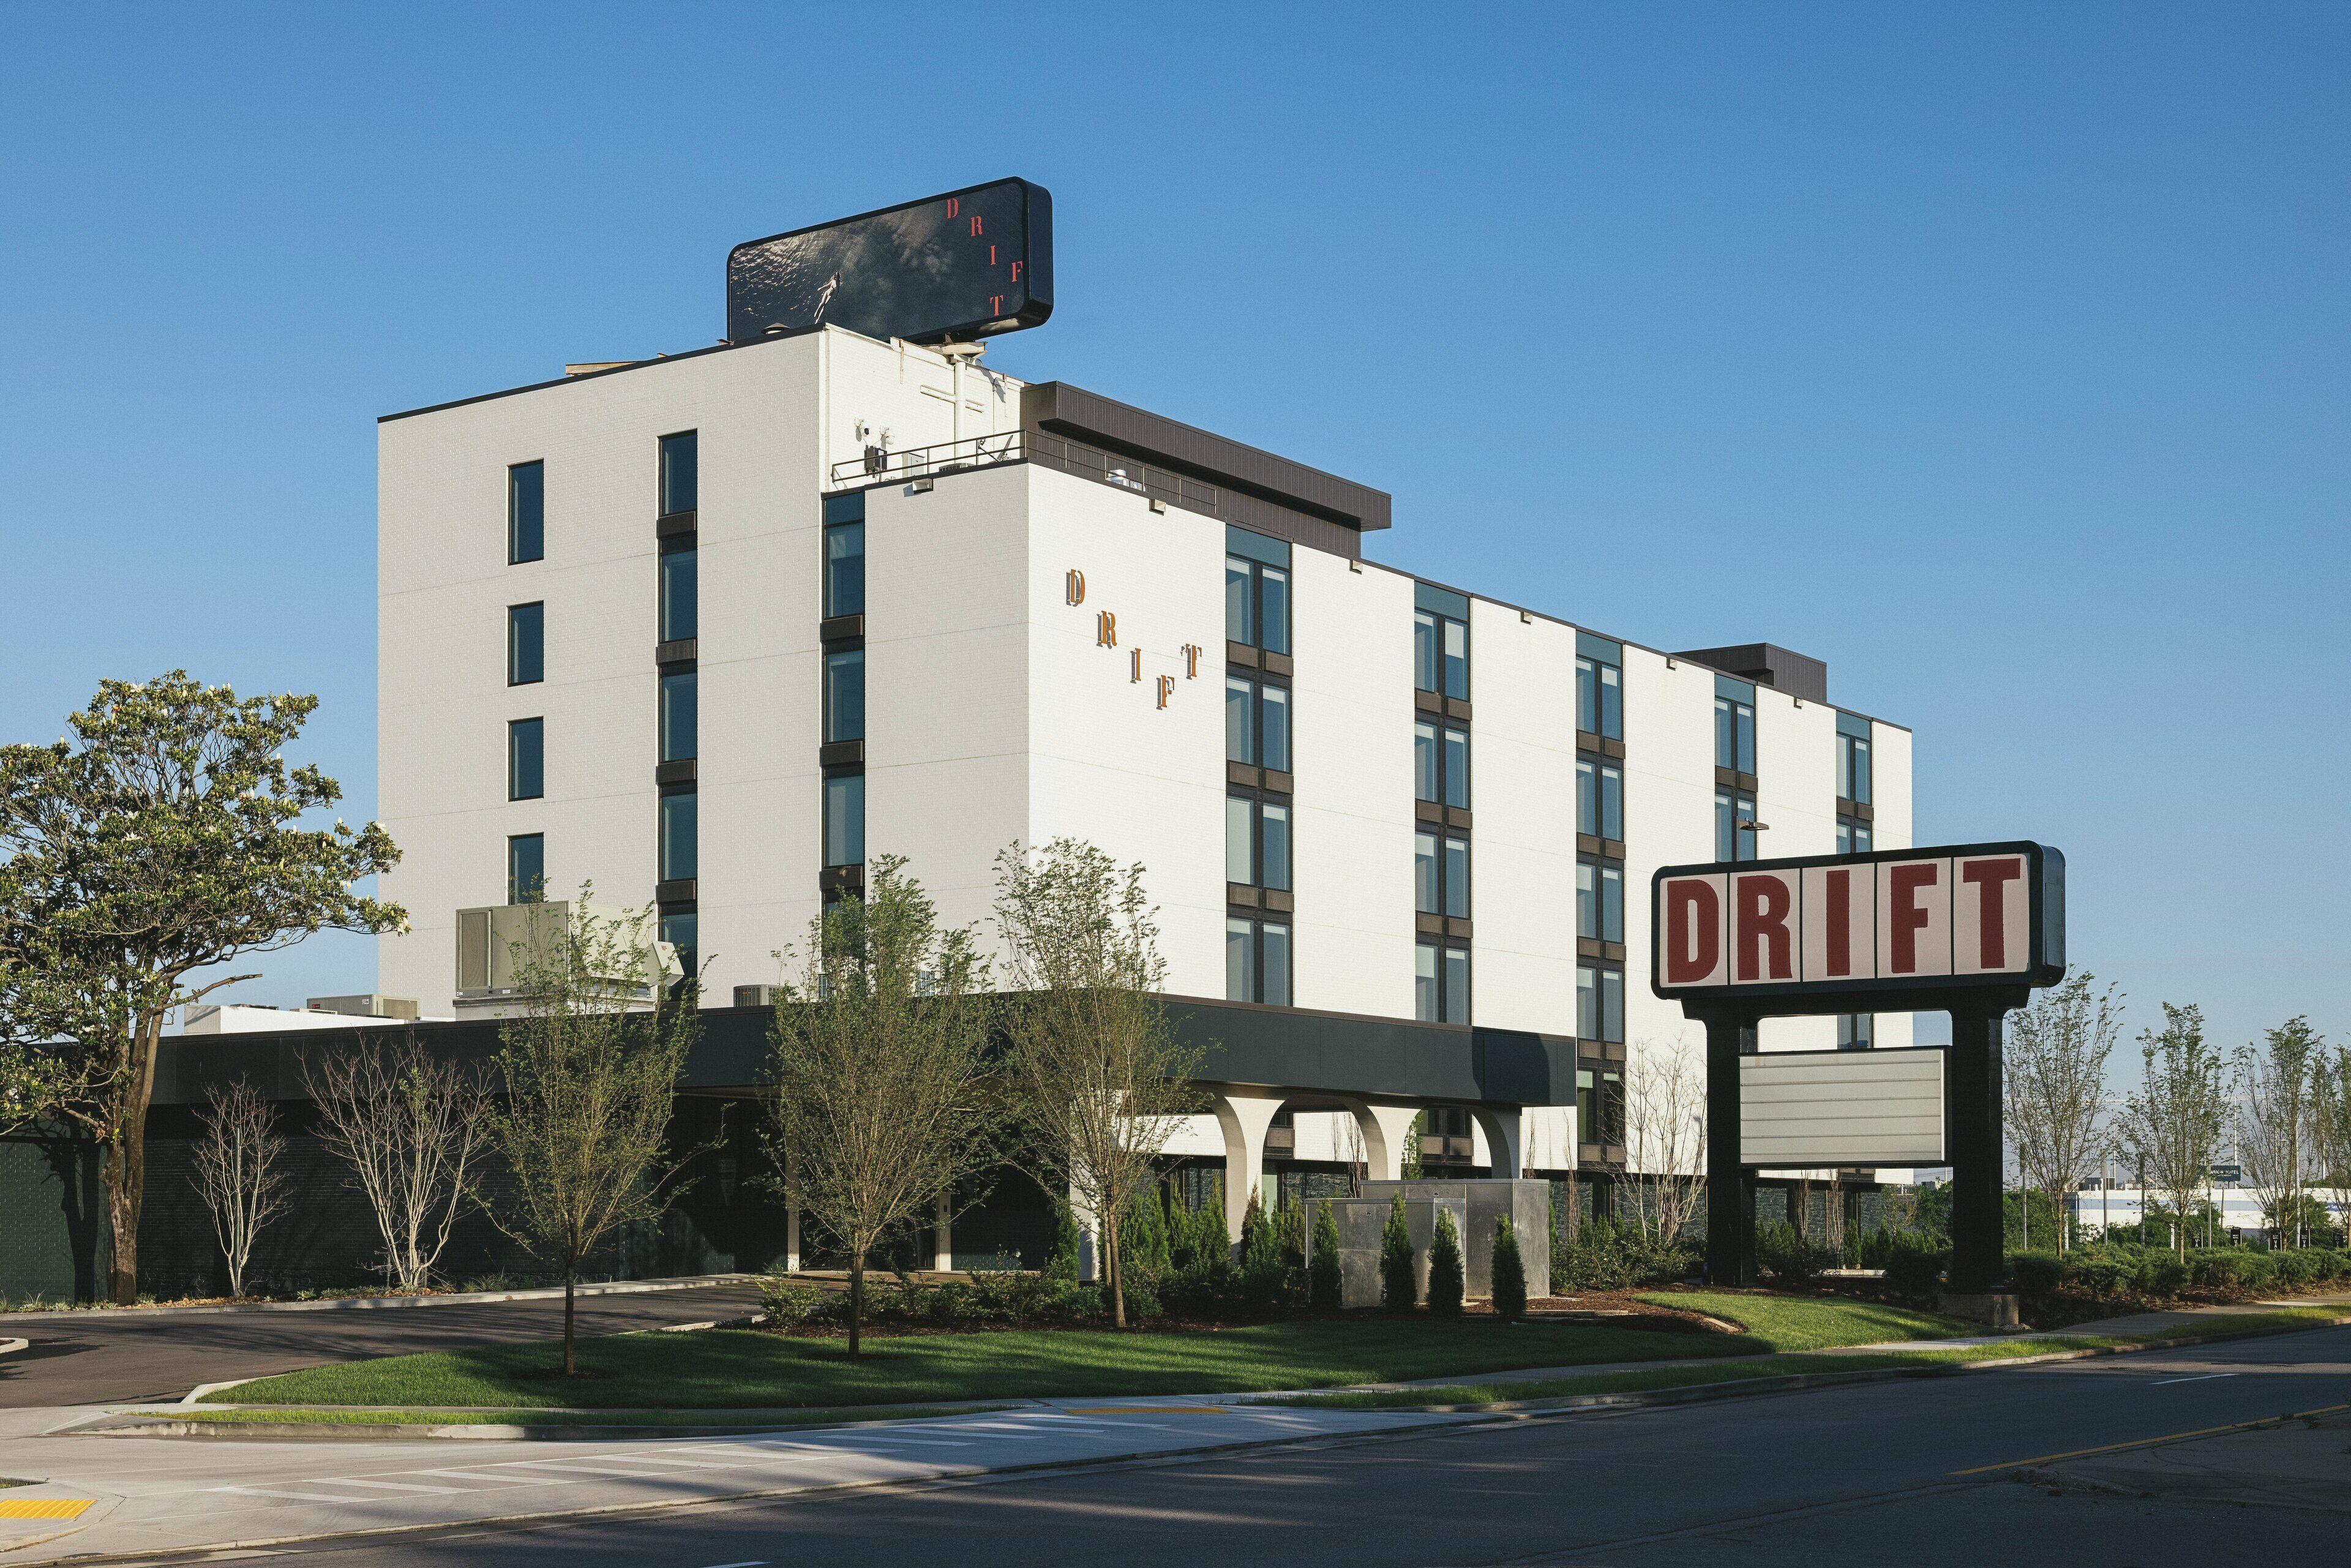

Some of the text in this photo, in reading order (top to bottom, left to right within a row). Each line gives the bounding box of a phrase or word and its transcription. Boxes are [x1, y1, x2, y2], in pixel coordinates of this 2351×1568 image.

[946, 198, 1023, 316] DRIFT
[1070, 569, 1202, 708] DRIFT
[1667, 858, 2021, 983] DRIFT
